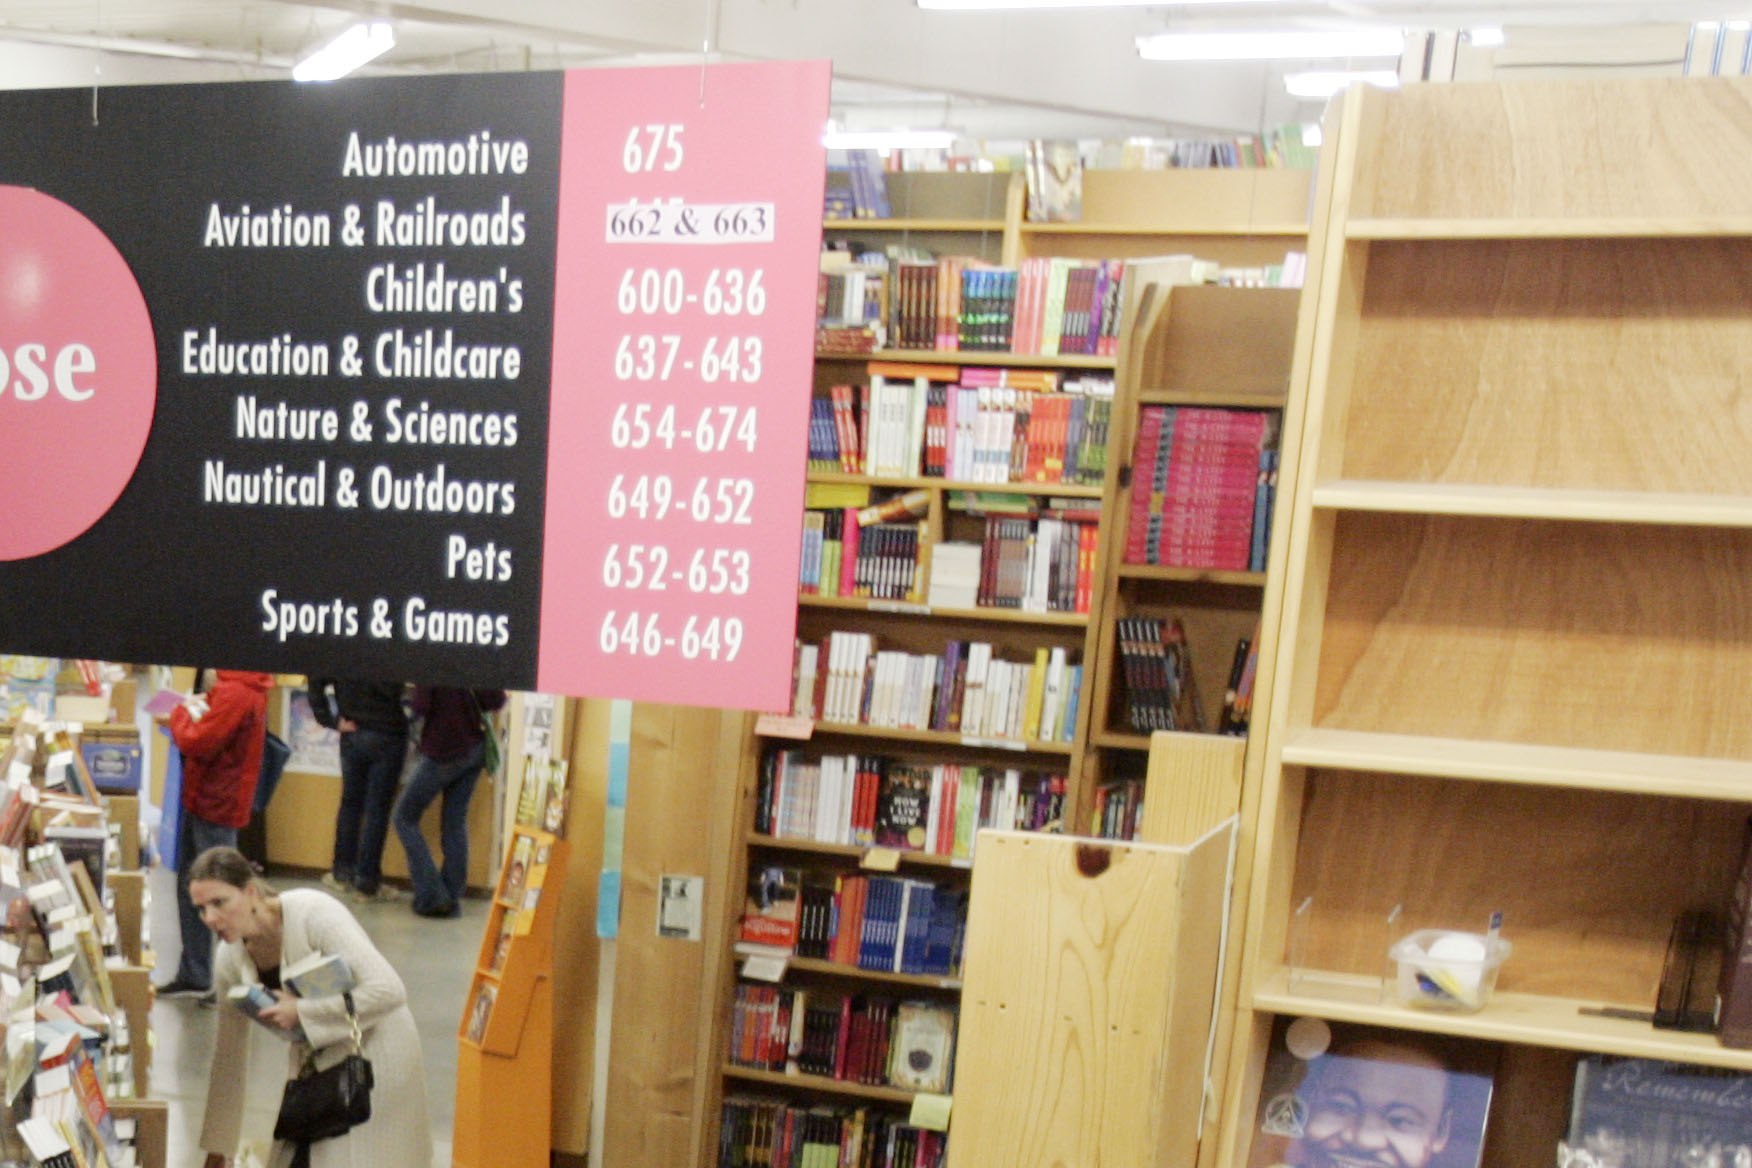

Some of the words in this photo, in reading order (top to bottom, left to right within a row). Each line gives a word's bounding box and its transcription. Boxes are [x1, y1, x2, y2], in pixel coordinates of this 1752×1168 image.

[342, 131, 529, 177] Automotive
[623, 124, 685, 174] 675
[203, 203, 331, 248] Aviation
[341, 204, 365, 247] &
[376, 196, 527, 247] Railroads
[610, 209, 662, 236] 662
[673, 208, 700, 236] &
[713, 207, 767, 236] 663
[366, 263, 524, 314] Children's
[617, 267, 767, 316] 600-636
[182, 327, 330, 377] Education
[340, 335, 363, 378] &
[375, 329, 522, 380] Childcare
[614, 334, 763, 384] 637-643
[236, 395, 339, 441] Nature
[349, 401, 373, 442] &
[385, 398, 519, 447] Sciences
[610, 402, 758, 453] 654-674
[204, 460, 326, 507] Nautical
[336, 467, 359, 508] &
[370, 463, 516, 515] Outdoors
[607, 474, 755, 525] 649-652
[447, 534, 513, 582] Pets
[602, 544, 751, 596] 652-653
[260, 589, 360, 643] Sports
[370, 598, 393, 639] &
[405, 595, 510, 647] Games
[599, 610, 744, 662] 646-649
